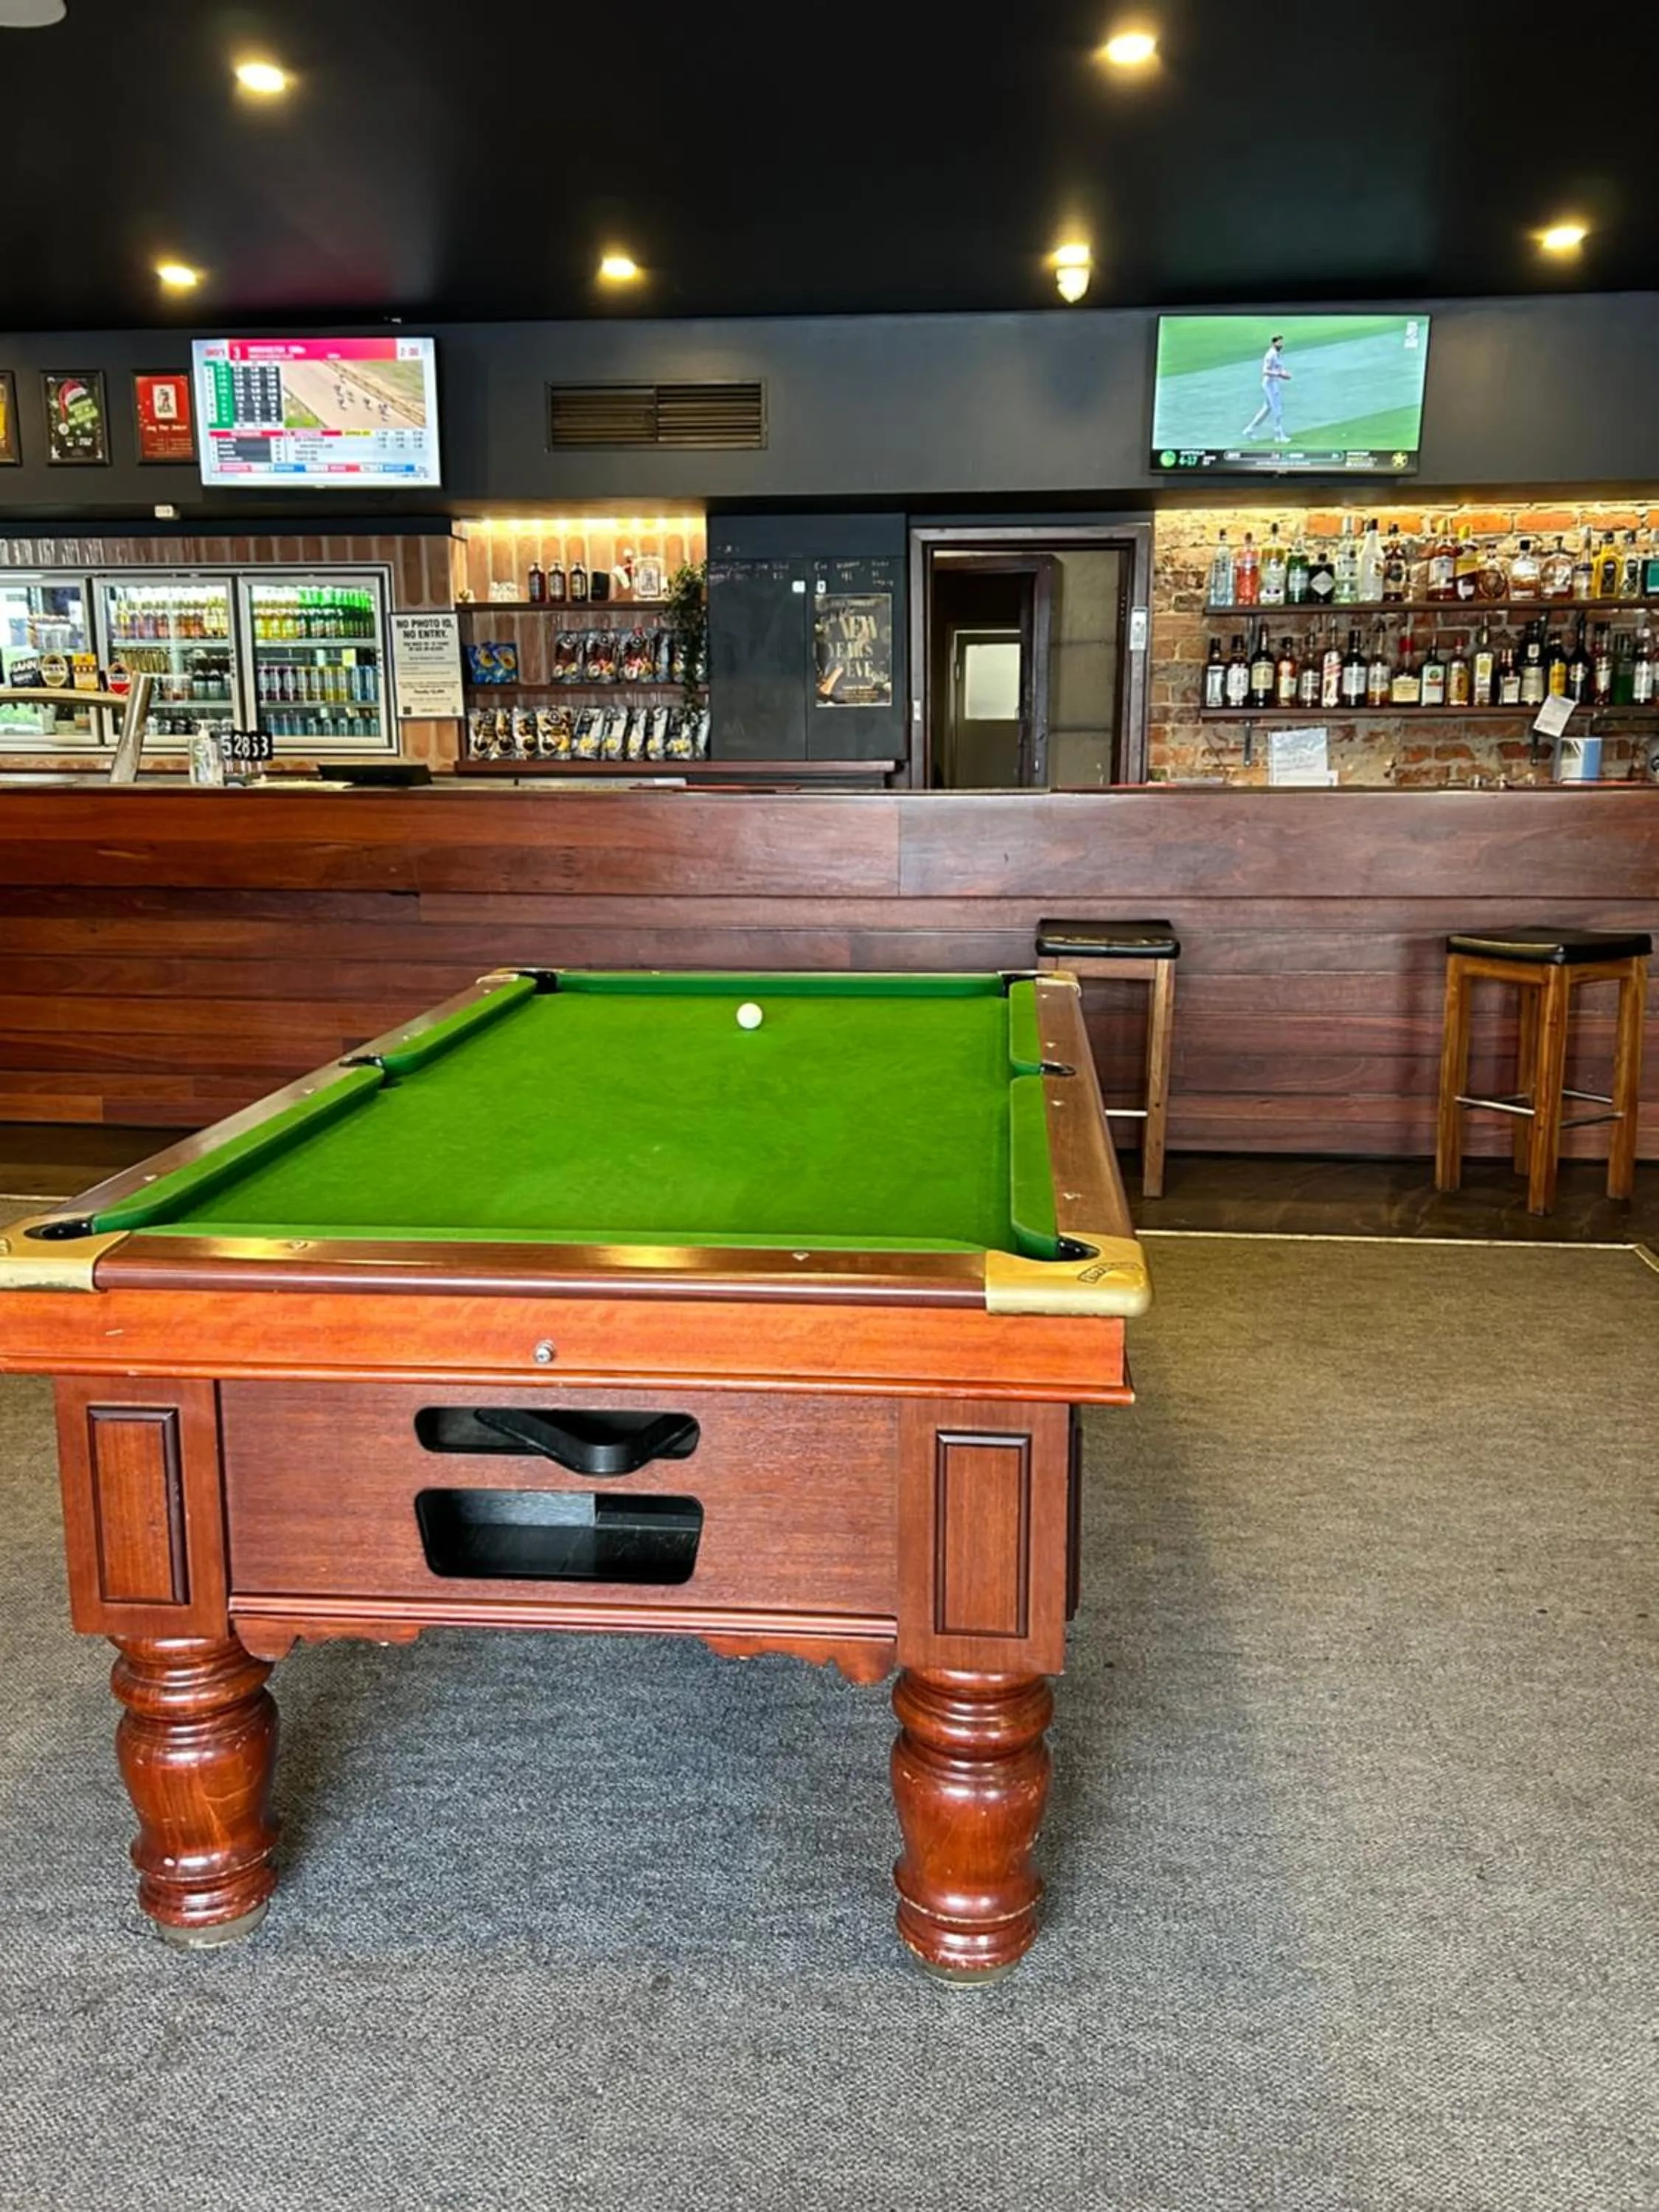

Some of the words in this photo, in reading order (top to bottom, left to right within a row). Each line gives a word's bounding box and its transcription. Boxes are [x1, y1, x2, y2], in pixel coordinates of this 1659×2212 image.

[397, 619, 408, 628] NO
[411, 619, 440, 628] PHOTO
[403, 630, 416, 639] NO
